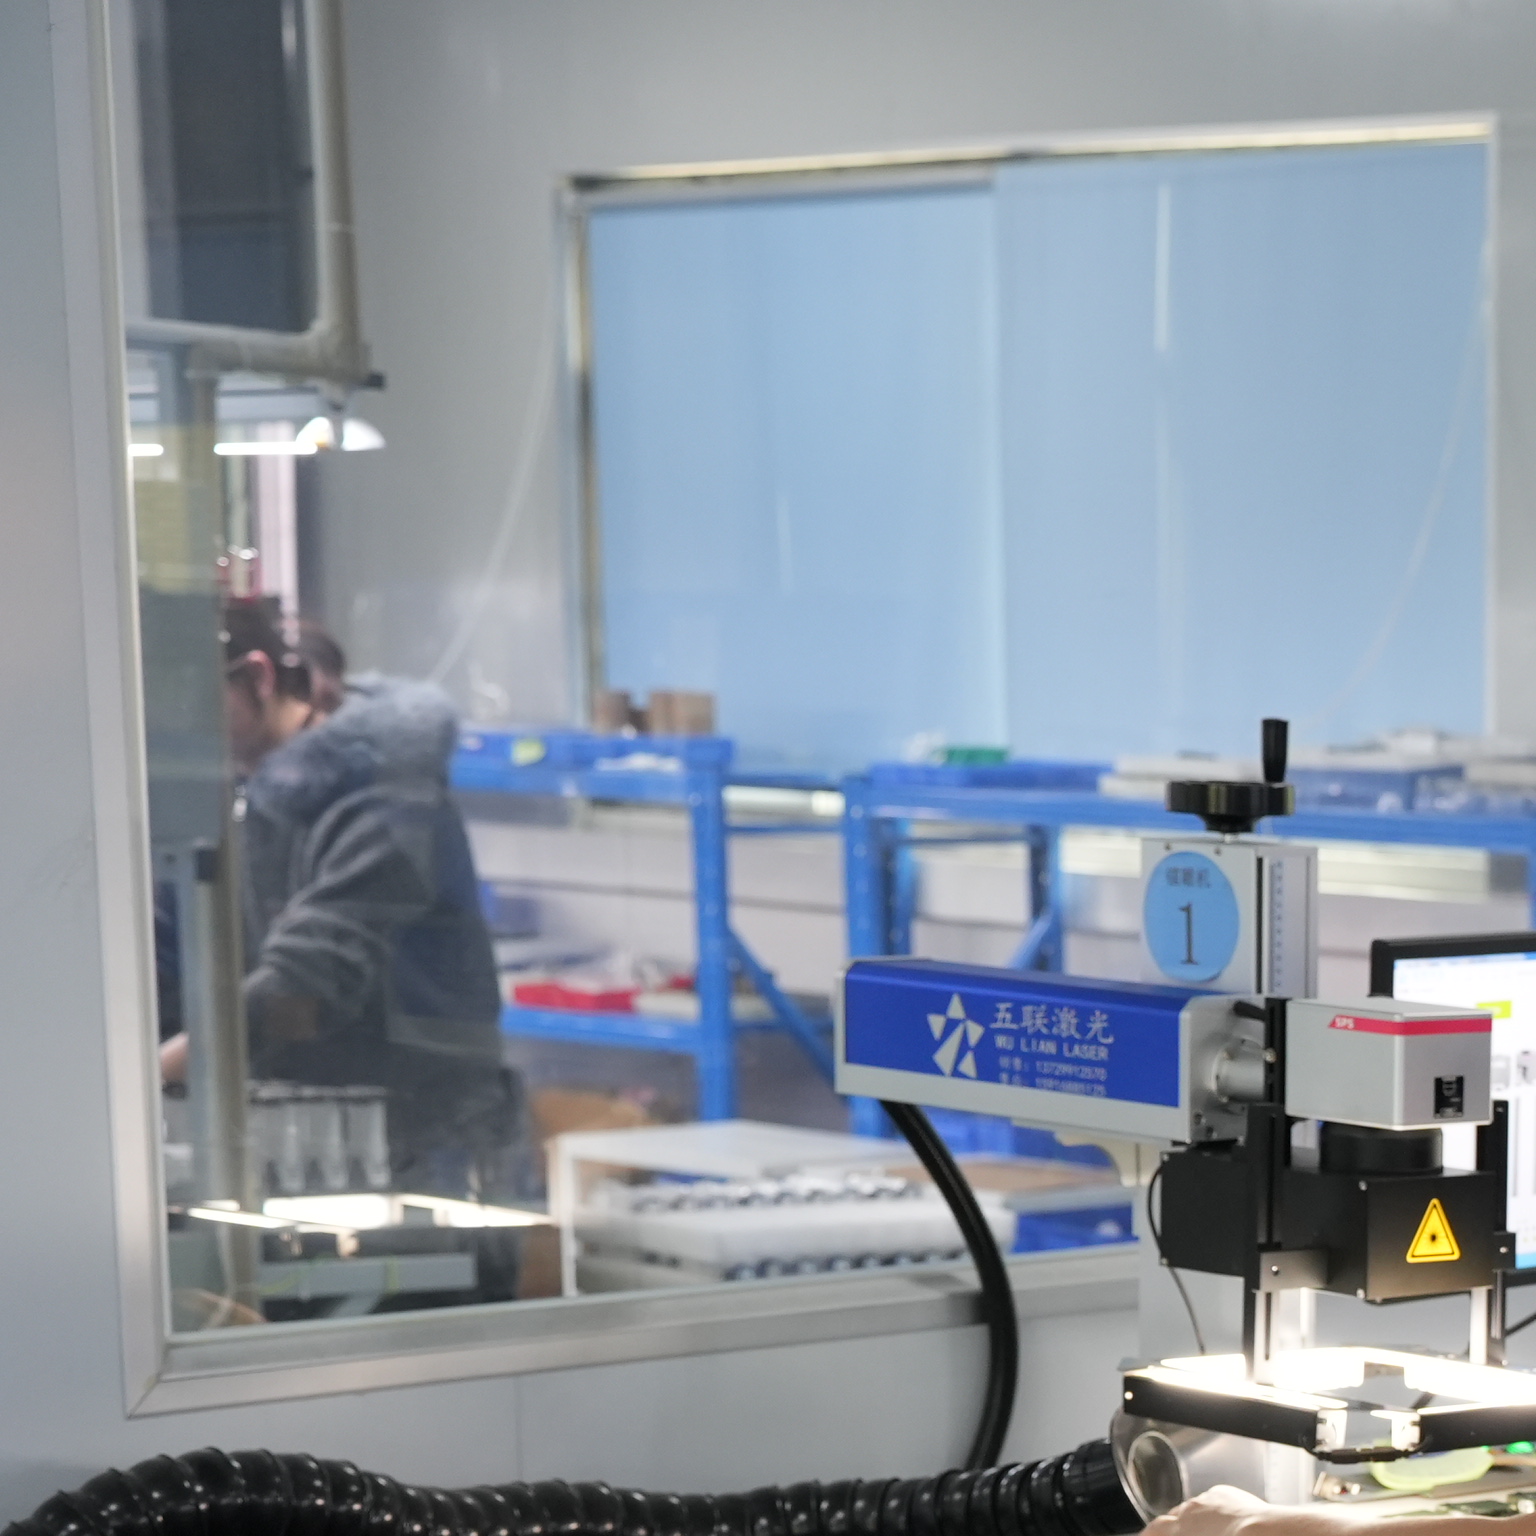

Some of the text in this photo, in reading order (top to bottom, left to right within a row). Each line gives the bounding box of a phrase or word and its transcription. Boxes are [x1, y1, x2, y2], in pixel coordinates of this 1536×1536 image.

[1179, 902, 1199, 965] 1
[990, 1003, 1114, 1044] 五联激光
[995, 1035, 1109, 1061] WU LIAN LASER
